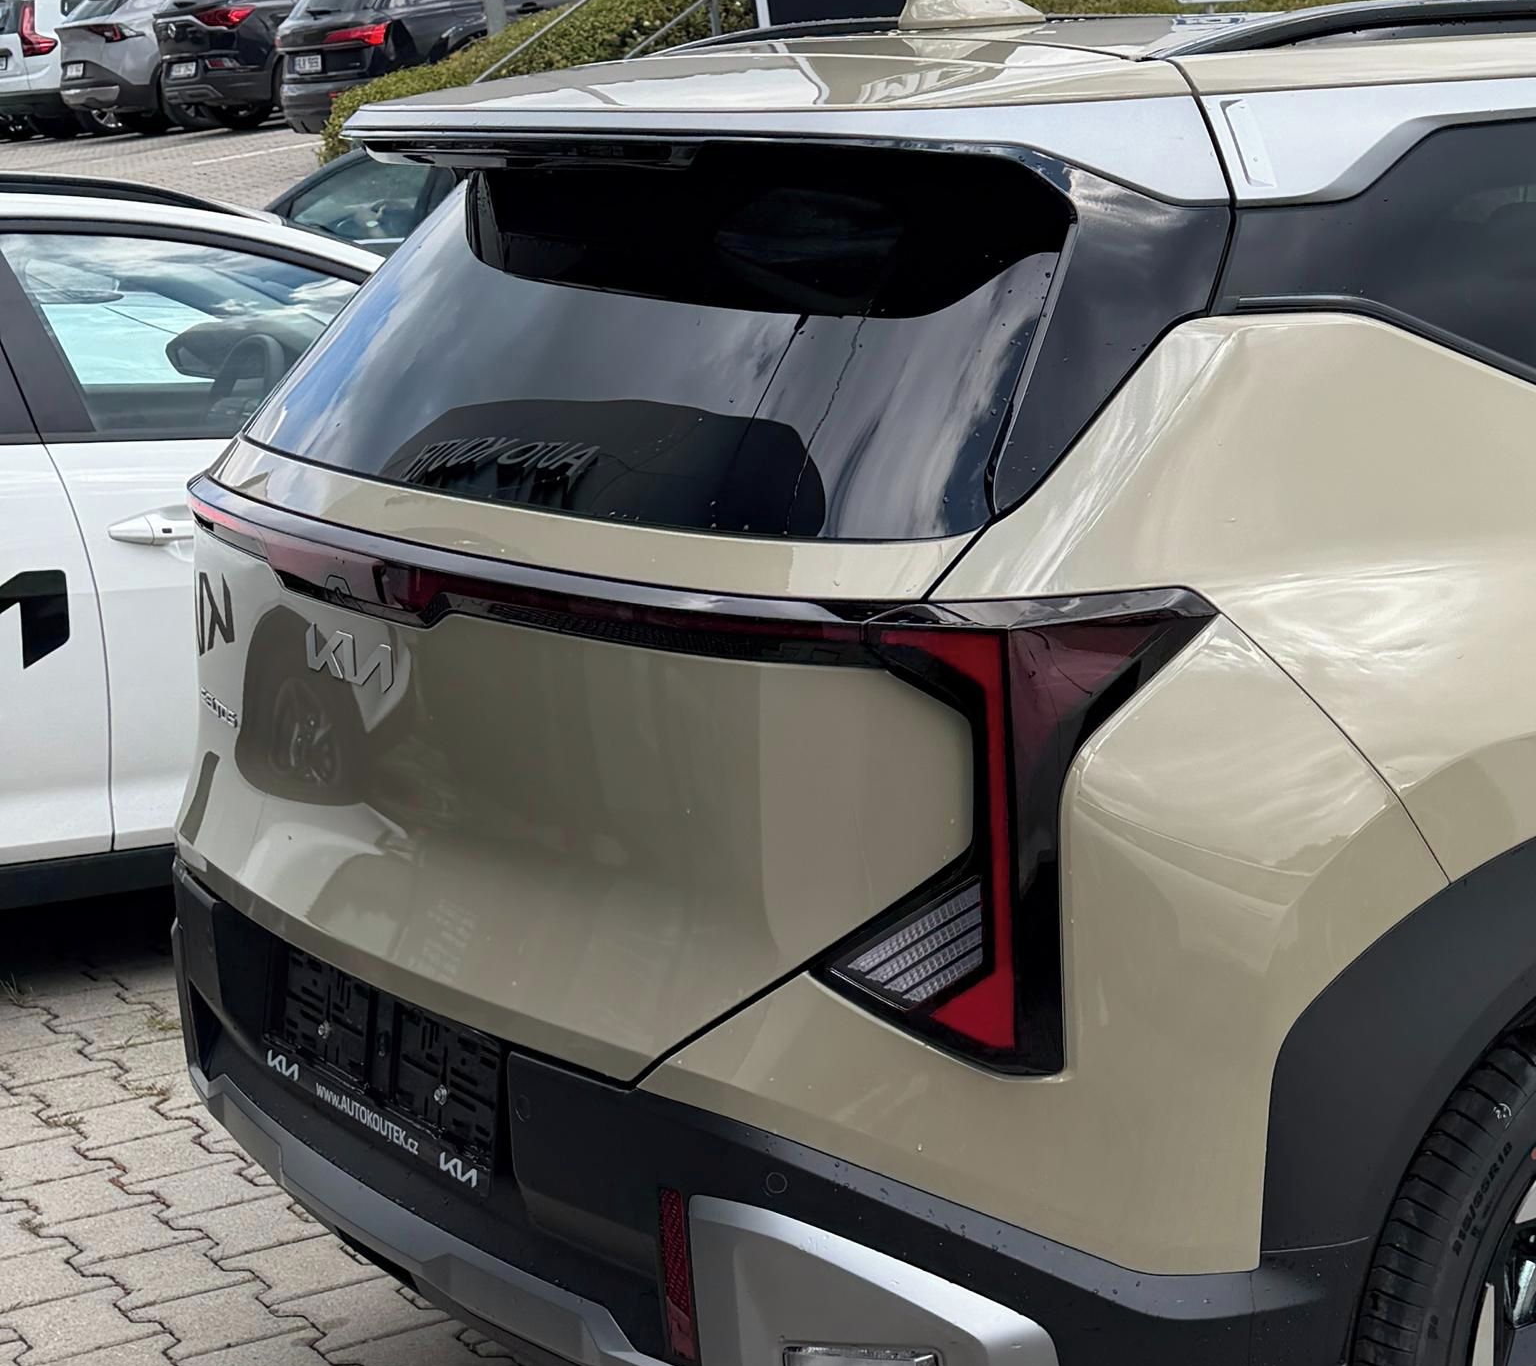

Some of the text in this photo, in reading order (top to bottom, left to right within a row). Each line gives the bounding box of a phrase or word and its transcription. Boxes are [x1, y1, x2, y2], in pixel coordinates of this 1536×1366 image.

[305, 621, 395, 695] KIA
[266, 1048, 300, 1082] KIA
[315, 1082, 420, 1156] www.AUTOKOUTEK.cz
[439, 1150, 478, 1189] KIA
